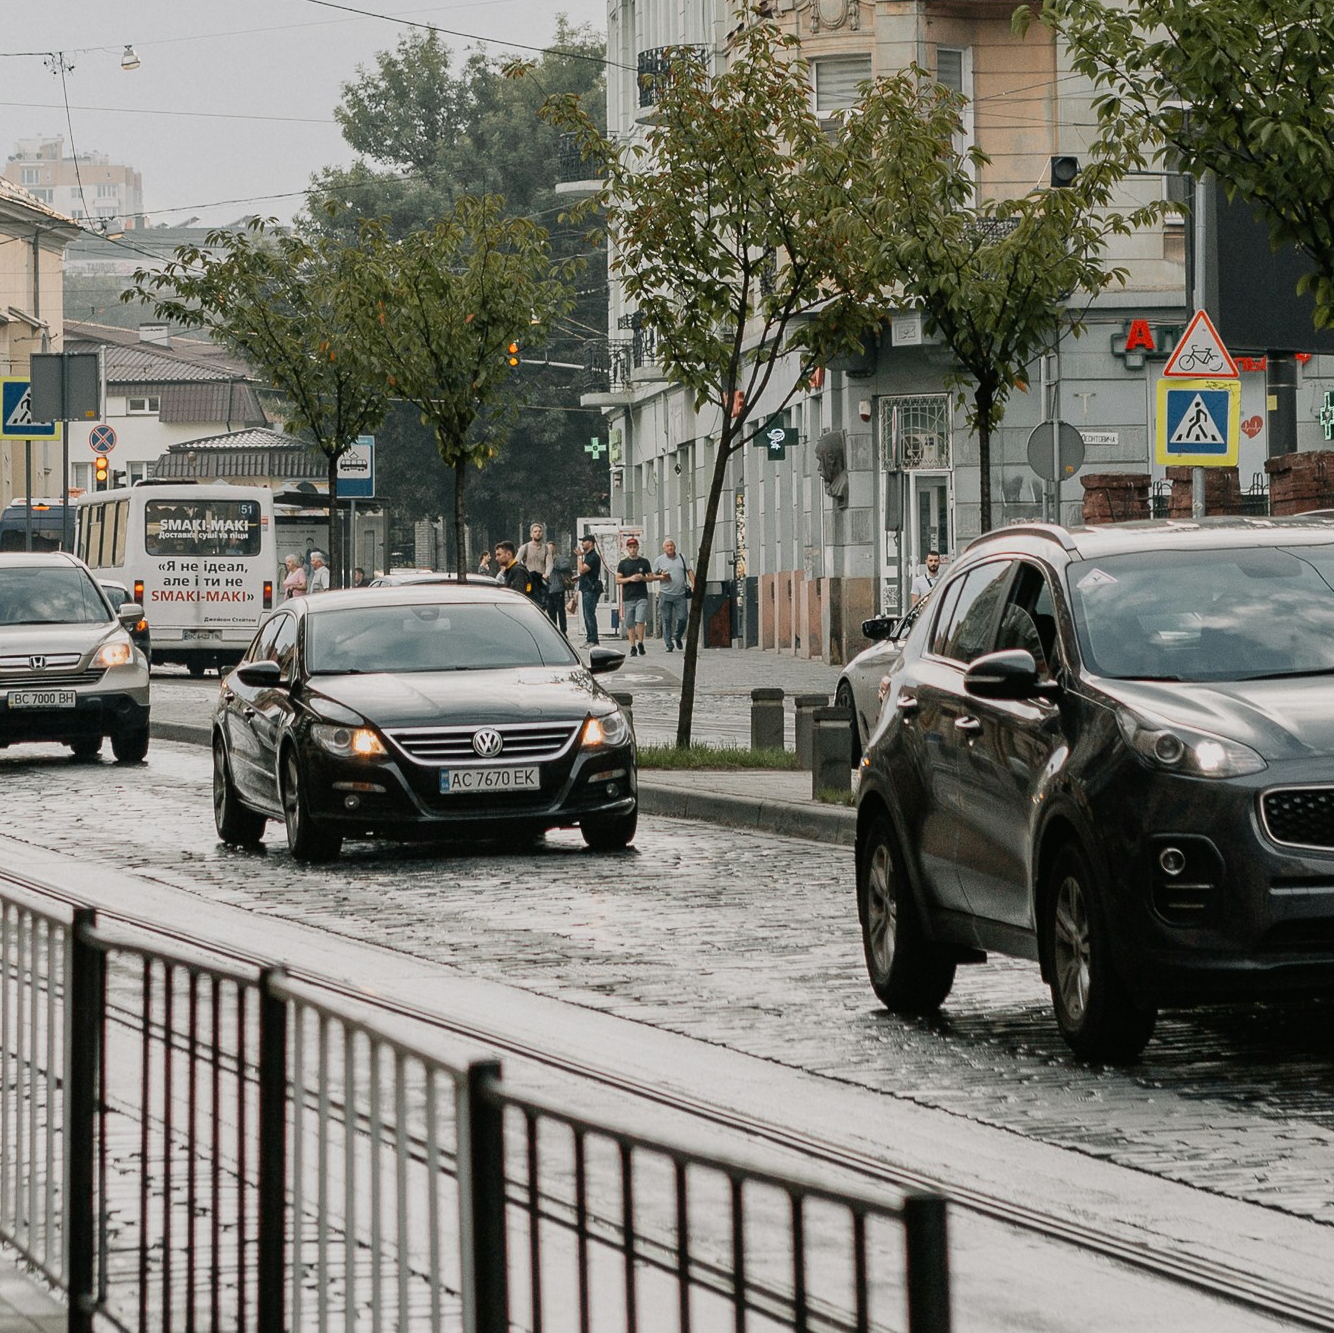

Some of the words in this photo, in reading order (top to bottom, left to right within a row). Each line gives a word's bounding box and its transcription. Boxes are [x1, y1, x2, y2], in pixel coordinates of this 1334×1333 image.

[240, 505, 253, 515] 51
[160, 519, 249, 532] SMAKI-MAKI
[159, 531, 196, 540] Доставка
[199, 531, 218, 540] суші
[158, 560, 176, 572] «Я
[180, 562, 199, 572] не
[203, 560, 249, 574] ідеал,
[163, 576, 189, 587] але
[194, 574, 199, 587] і
[203, 577, 221, 587] ти
[225, 577, 243, 587] не
[151, 590, 255, 603] SMAKI-MAKI»
[14, 693, 29, 704] BC
[32, 693, 56, 704] 7000
[58, 693, 74, 704] BH
[451, 772, 472, 788] AC
[475, 771, 510, 787] 7670
[514, 769, 535, 785] EK
